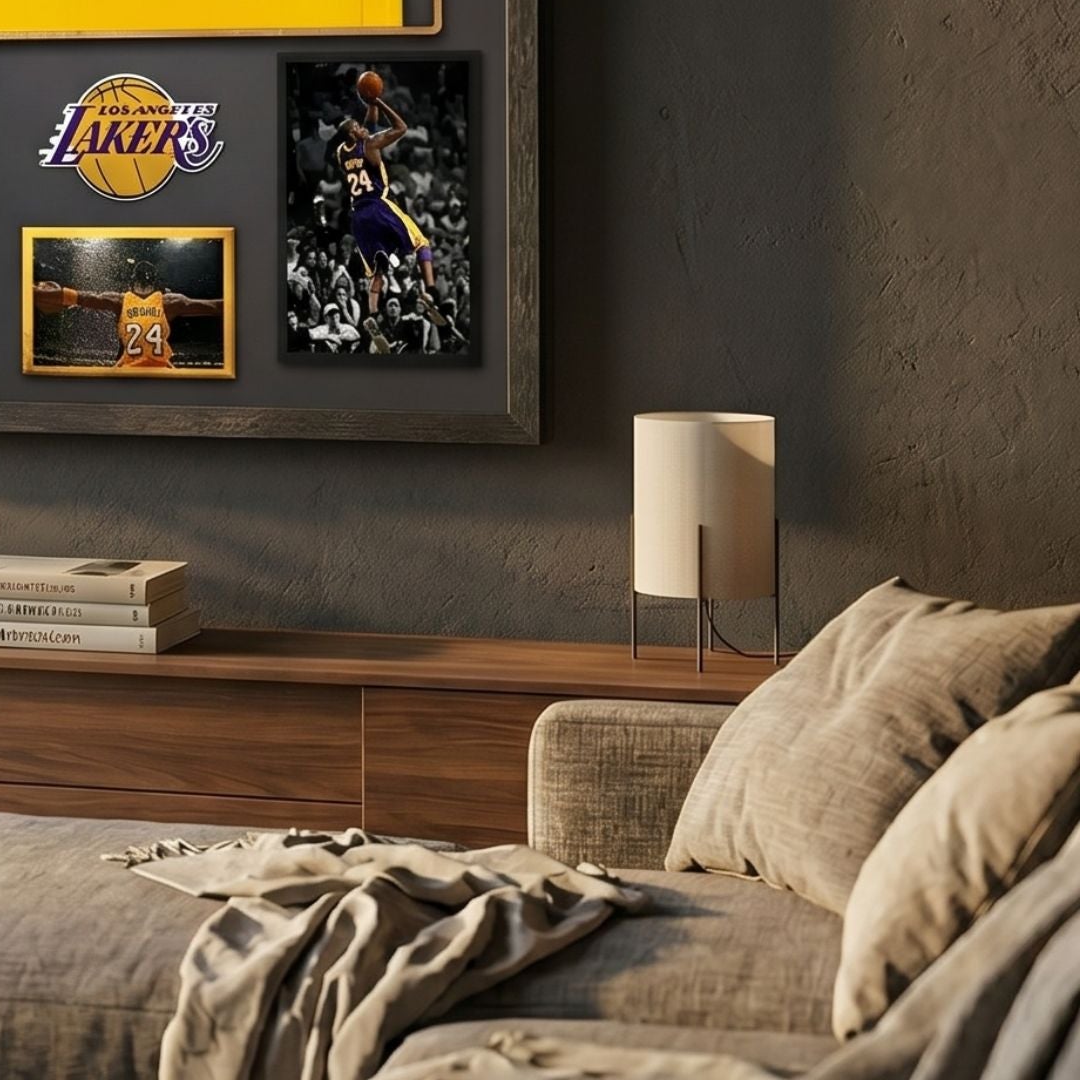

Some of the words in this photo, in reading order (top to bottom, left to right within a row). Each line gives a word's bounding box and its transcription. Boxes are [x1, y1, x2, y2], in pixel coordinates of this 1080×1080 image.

[98, 104, 130, 116] LOS
[45, 105, 221, 171] LAKERS
[347, 169, 375, 197] 24
[125, 322, 163, 356] 24
